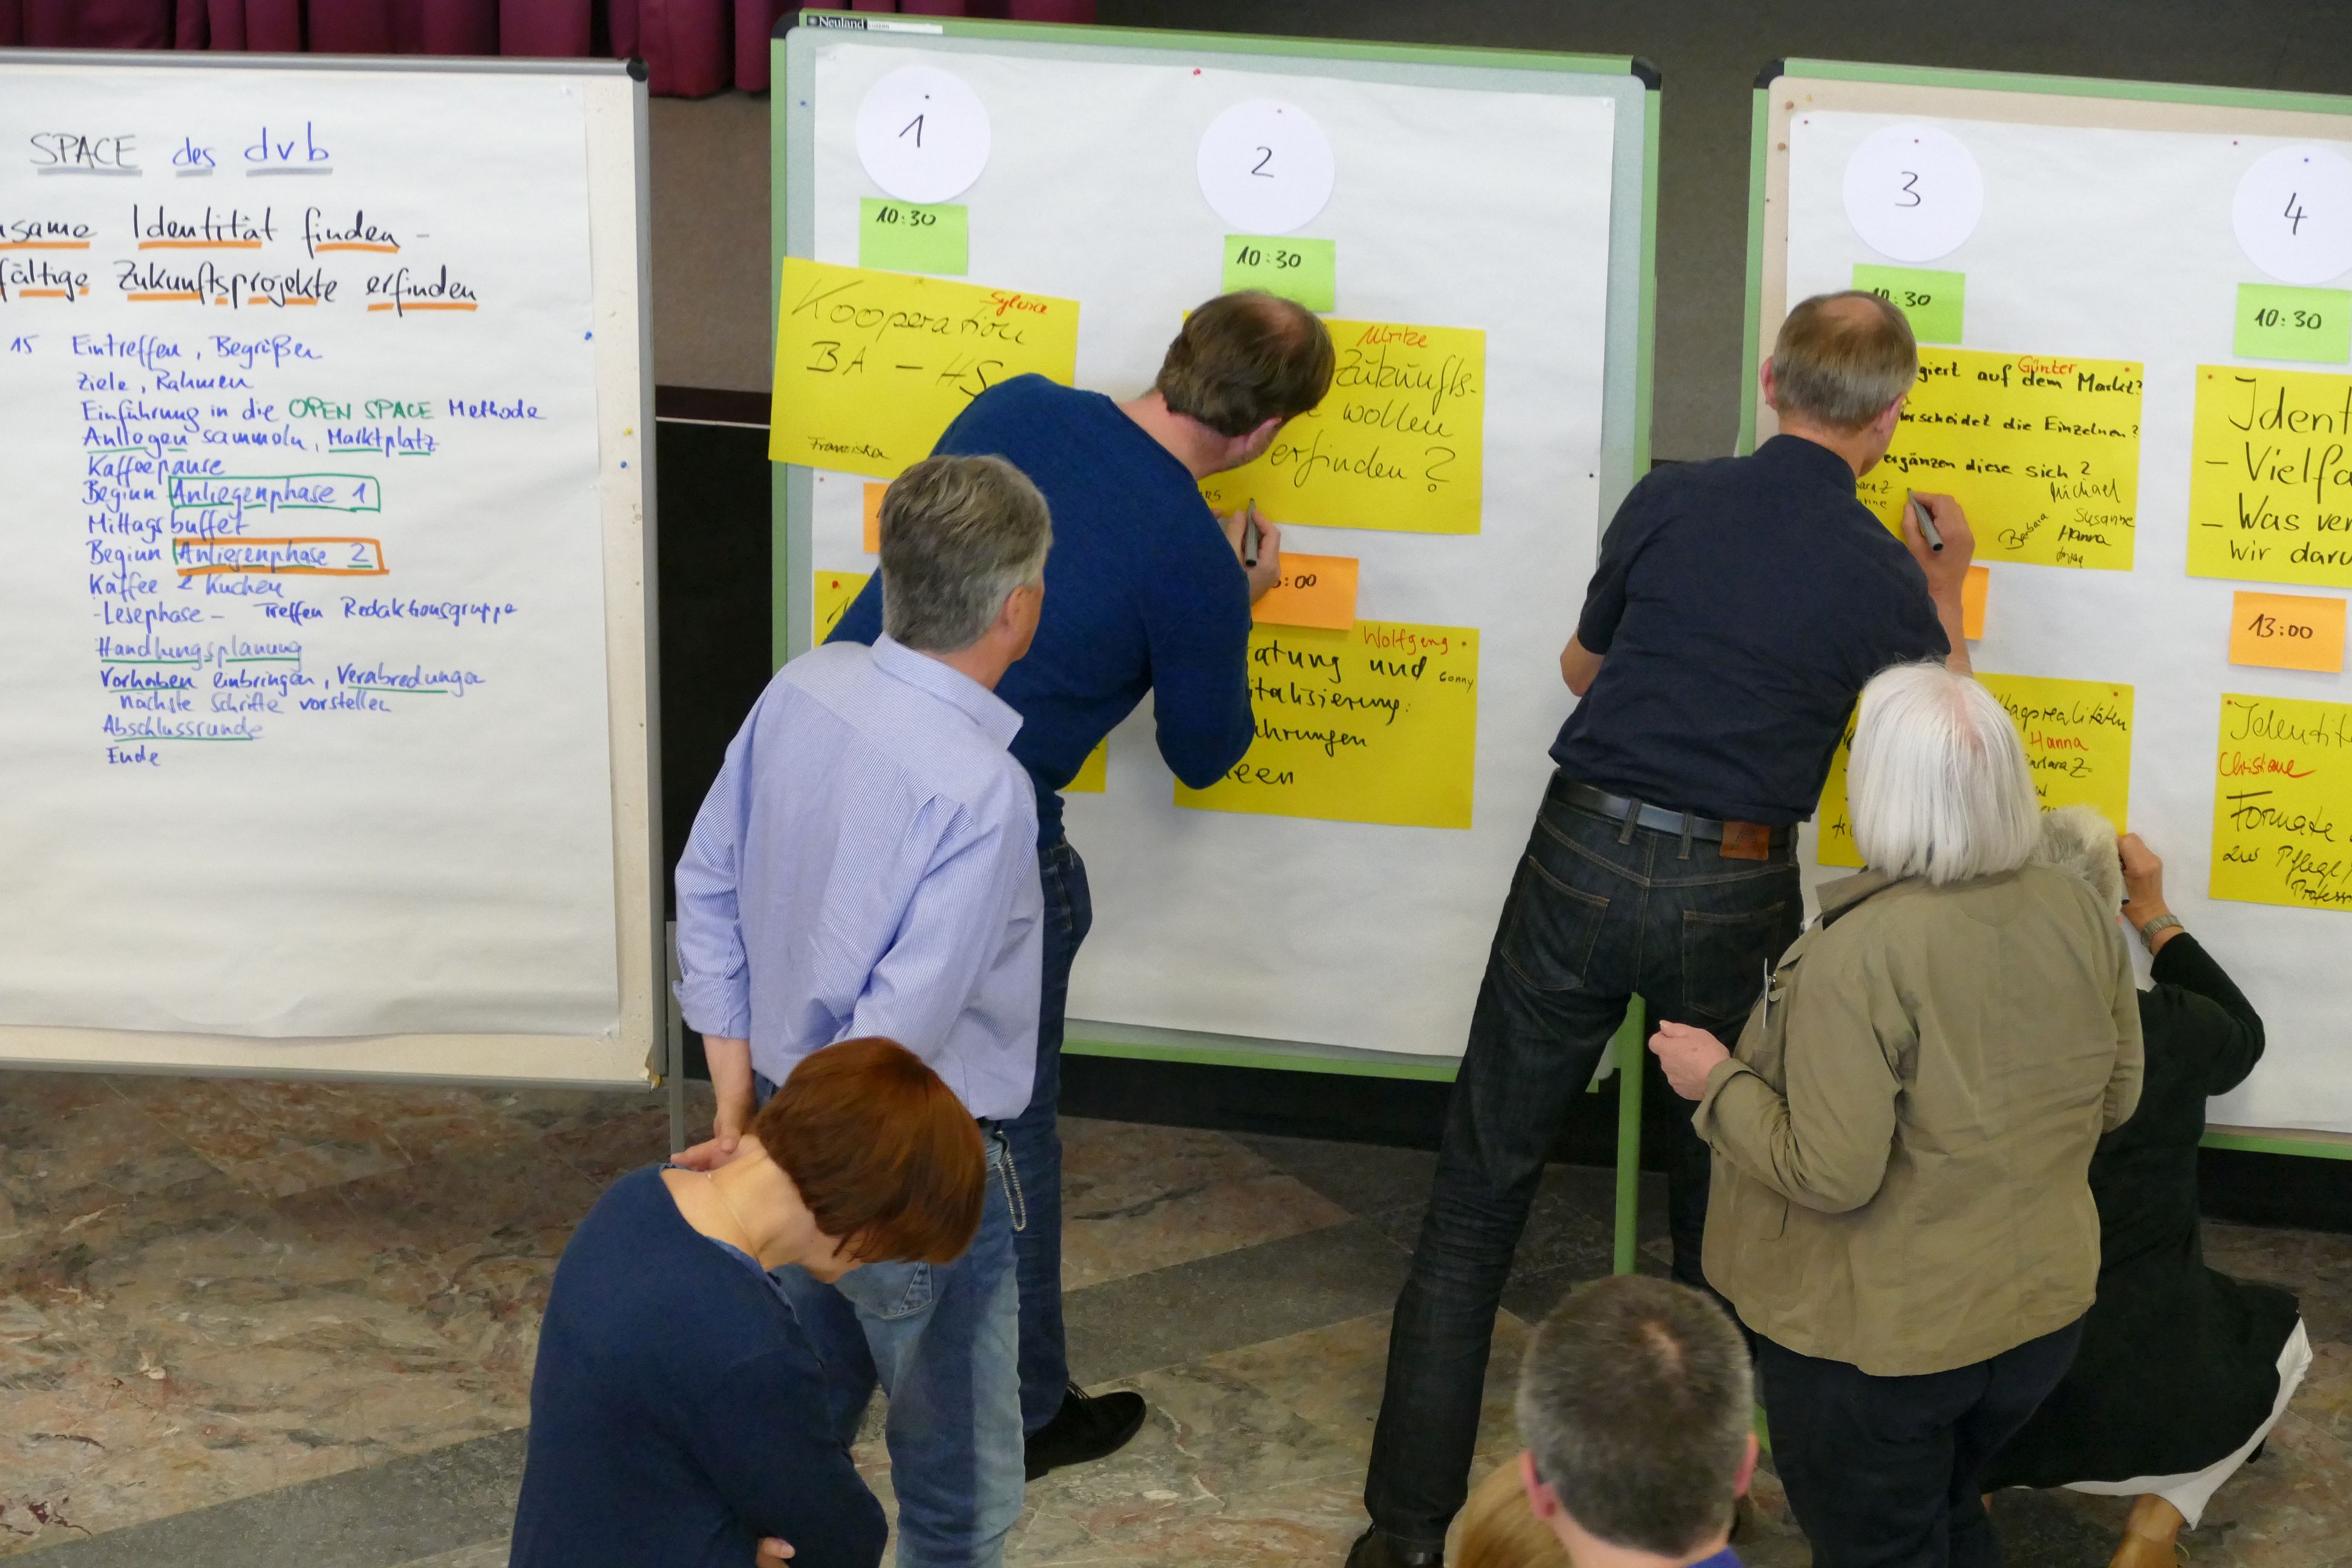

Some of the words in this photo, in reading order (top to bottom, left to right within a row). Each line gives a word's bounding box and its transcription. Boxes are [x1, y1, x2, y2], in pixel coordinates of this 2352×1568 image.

[818, 16, 865, 30] Neuland
[899, 114, 924, 148] 1
[30, 132, 139, 169] SPACE
[172, 136, 216, 168] des
[1250, 146, 1275, 178] 2
[1895, 171, 1921, 207] 3
[877, 206, 937, 227] 10:30
[2283, 192, 2308, 235] 4
[133, 203, 278, 241] Identität
[301, 207, 400, 259] finden
[1236, 246, 1302, 269] 10:30
[0, 258, 88, 302] fältige
[113, 260, 337, 309] Zukunftsprojekte
[366, 264, 477, 317] erfinden
[791, 278, 1028, 345] Kooperation
[2255, 308, 2322, 330] 10:30
[10, 334, 39, 354] 15
[155, 368, 254, 392] Rahmen
[806, 341, 867, 376] BA
[935, 351, 1004, 397] HS
[1917, 361, 1961, 382] giert
[1977, 364, 2013, 387] auf
[2022, 370, 2063, 390] dem
[2017, 356, 2077, 375] Günter
[81, 398, 200, 433] Einführung
[211, 405, 229, 418] in
[242, 397, 281, 423] die
[288, 396, 351, 420] OPEN
[364, 399, 435, 420] SPACE
[449, 399, 547, 419] Methode
[1343, 399, 1453, 438] wollen
[1900, 411, 1990, 426] terscheidet
[2003, 417, 2033, 431] die
[327, 425, 440, 458] Marktplatz
[88, 454, 225, 487] Kaffeepause
[1271, 430, 1407, 488] erfinden
[1883, 452, 1956, 474] ergänzen
[1965, 458, 2013, 474] diese
[2025, 463, 2068, 479] sich
[82, 479, 156, 514] Beginn
[167, 477, 336, 514] Anliegenphase
[352, 483, 366, 503] 1
[2050, 477, 2121, 503] Michael
[2239, 492, 2300, 531] Was
[2057, 524, 2112, 546] Hanna
[85, 539, 162, 579] Beginn
[177, 540, 328, 573] Anliegenphase
[350, 543, 370, 563] 2
[90, 572, 158, 603] Kaffee
[206, 573, 284, 598] Kuchen
[252, 601, 324, 626] Treffen
[341, 596, 518, 627] Redaktionsgruppe
[2248, 613, 2314, 639] 13:00
[96, 634, 302, 673] Handlungsplanung
[1254, 639, 1341, 684] atung
[1369, 656, 1428, 681] und
[100, 667, 198, 690] Vorhaben
[299, 689, 392, 712] vorstellen
[1249, 677, 1411, 725] italisierung:
[102, 714, 265, 739] Abschlussrunde
[2030, 731, 2089, 752] Hanna
[105, 744, 161, 766] Ende
[1224, 763, 1293, 785] een
